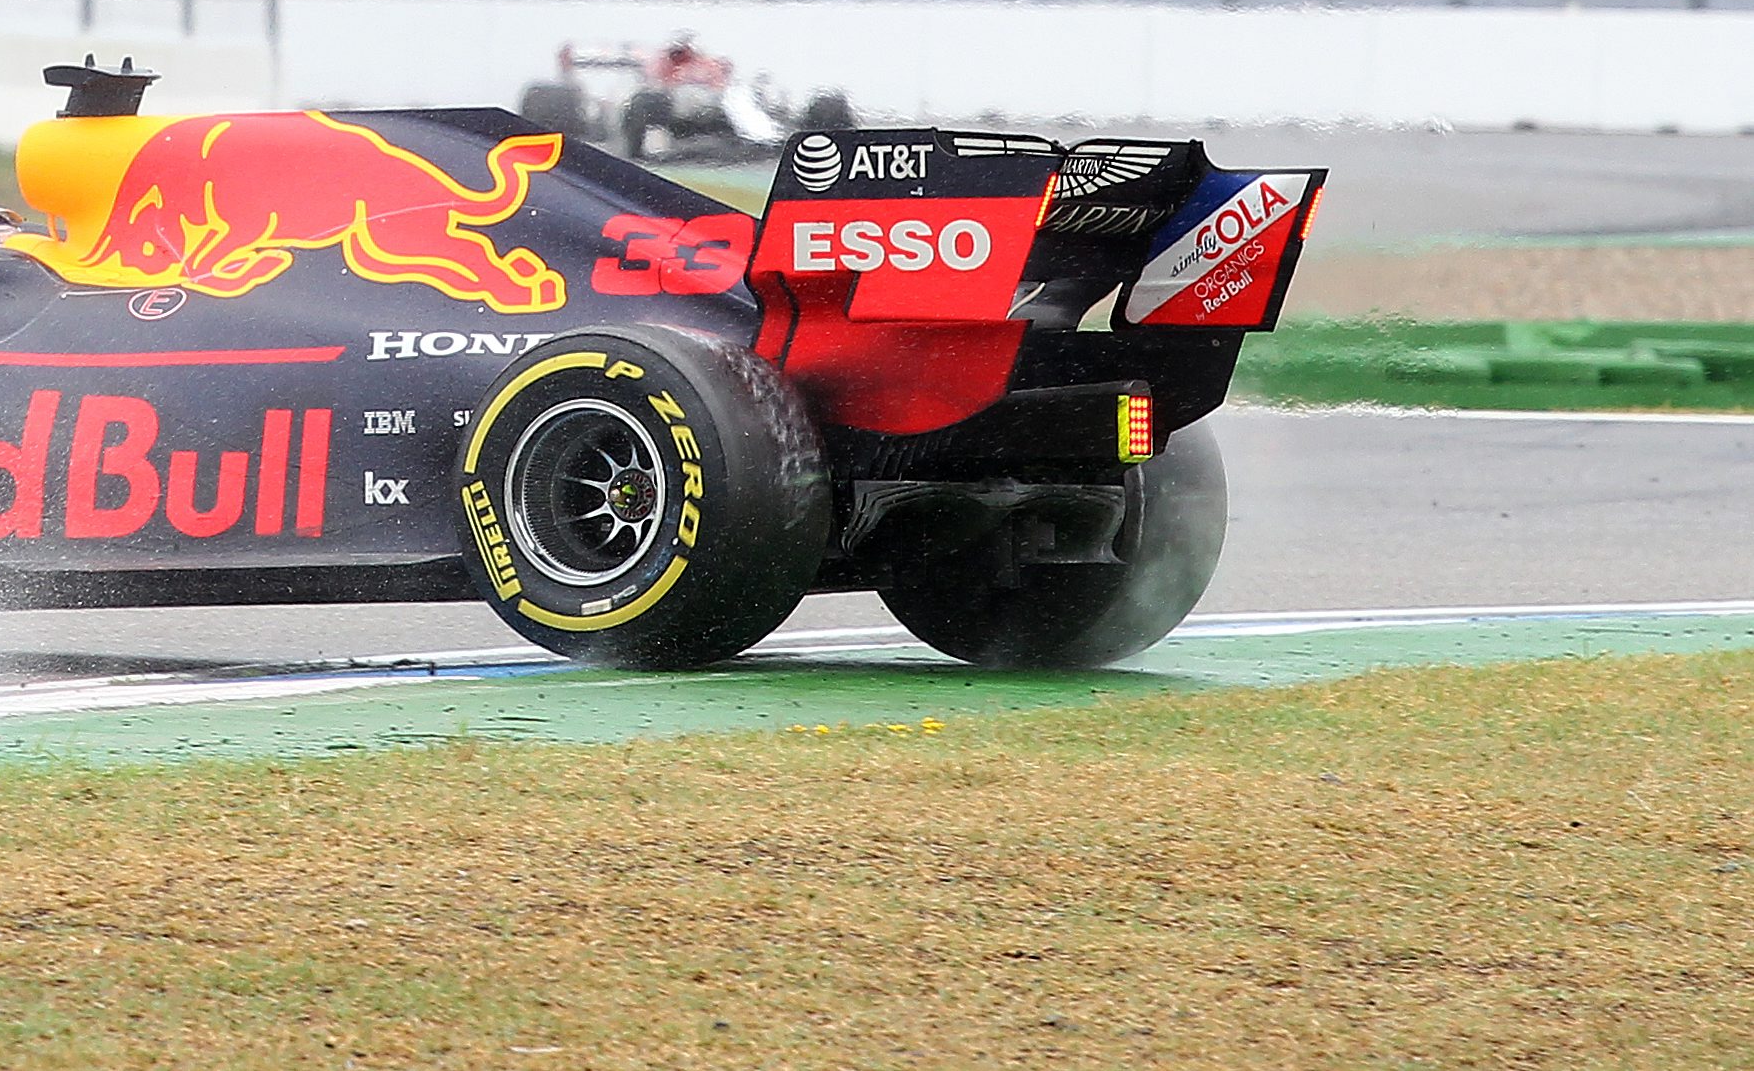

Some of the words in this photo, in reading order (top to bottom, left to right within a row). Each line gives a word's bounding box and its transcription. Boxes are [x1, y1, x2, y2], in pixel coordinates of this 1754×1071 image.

[849, 144, 933, 179] AT&T
[1060, 158, 1103, 175] MARTIN
[591, 213, 755, 295] 33
[793, 219, 991, 271] ESSO
[1170, 232, 1218, 277] simply
[1196, 181, 1290, 260] COLA
[1194, 240, 1265, 298] ORGANICS
[363, 410, 416, 434] IBM
[604, 360, 645, 379] P
[648, 390, 704, 549] ZERO
[364, 471, 410, 505] kx
[461, 480, 523, 602] PIRELLI
